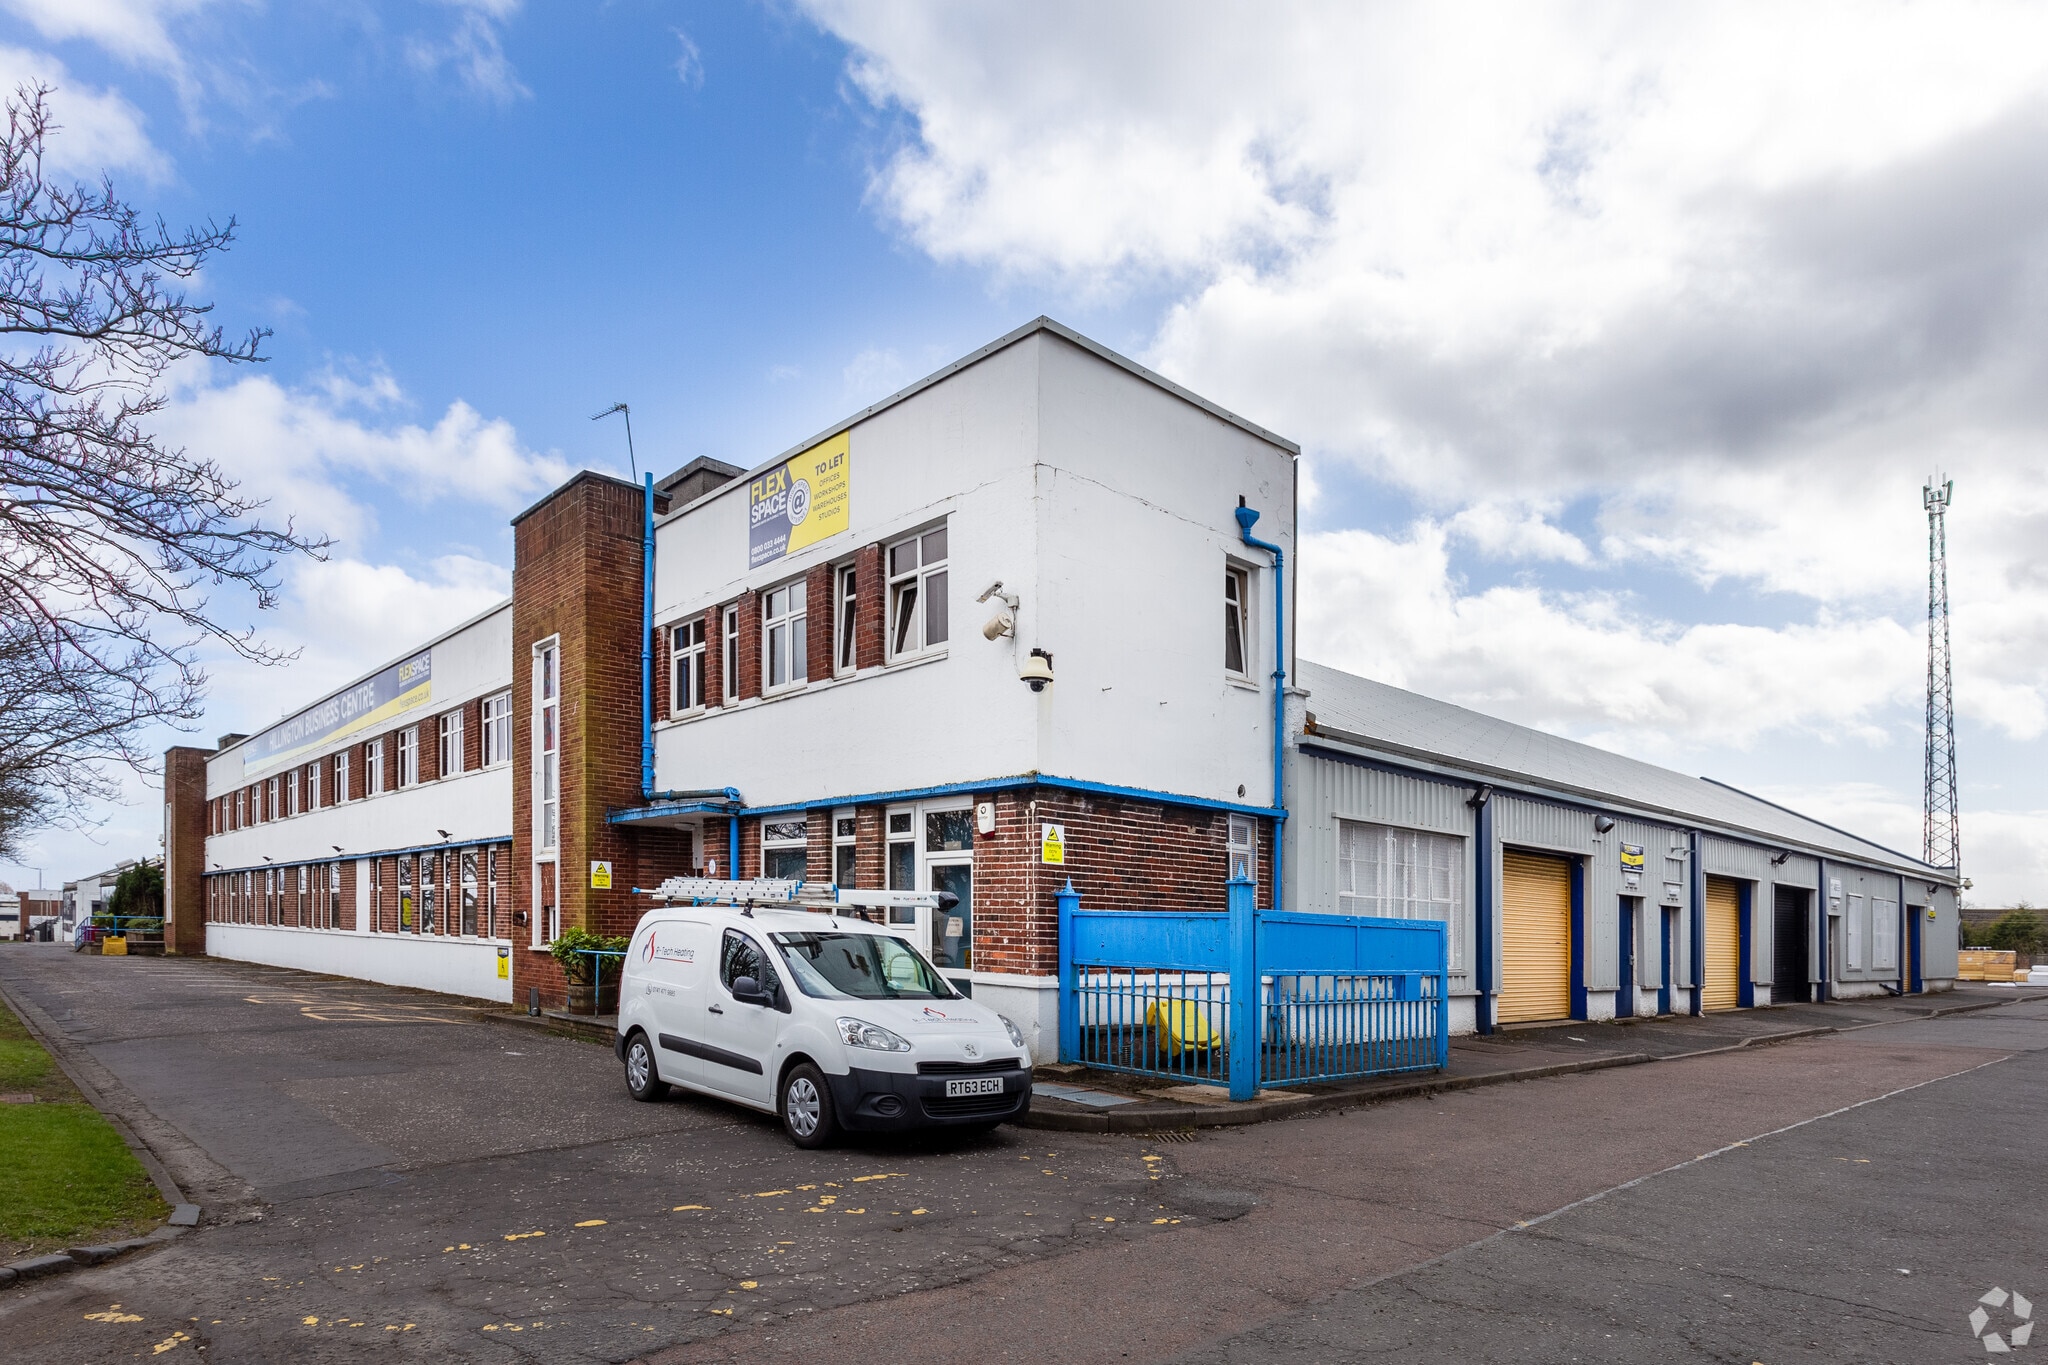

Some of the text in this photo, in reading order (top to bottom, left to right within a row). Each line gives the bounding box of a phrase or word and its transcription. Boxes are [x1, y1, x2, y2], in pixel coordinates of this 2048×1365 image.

[815, 453, 844, 476] TO LET
[751, 469, 786, 506] FLEX
[819, 472, 840, 487] OFFICES
[813, 481, 846, 500] WORKSHOPS
[751, 491, 786, 524] SPACE
[812, 491, 847, 512] WAREHOUSES
[818, 506, 841, 521] STUDIOS
[751, 534, 786, 556] 0800 033 4444
[269, 714, 304, 751] HILLINGTON
[305, 700, 340, 737] BUSINESS
[341, 682, 375, 718] CENTRE
[674, 947, 694, 960] Heating
[950, 1079, 999, 1095] RT63 ECH
